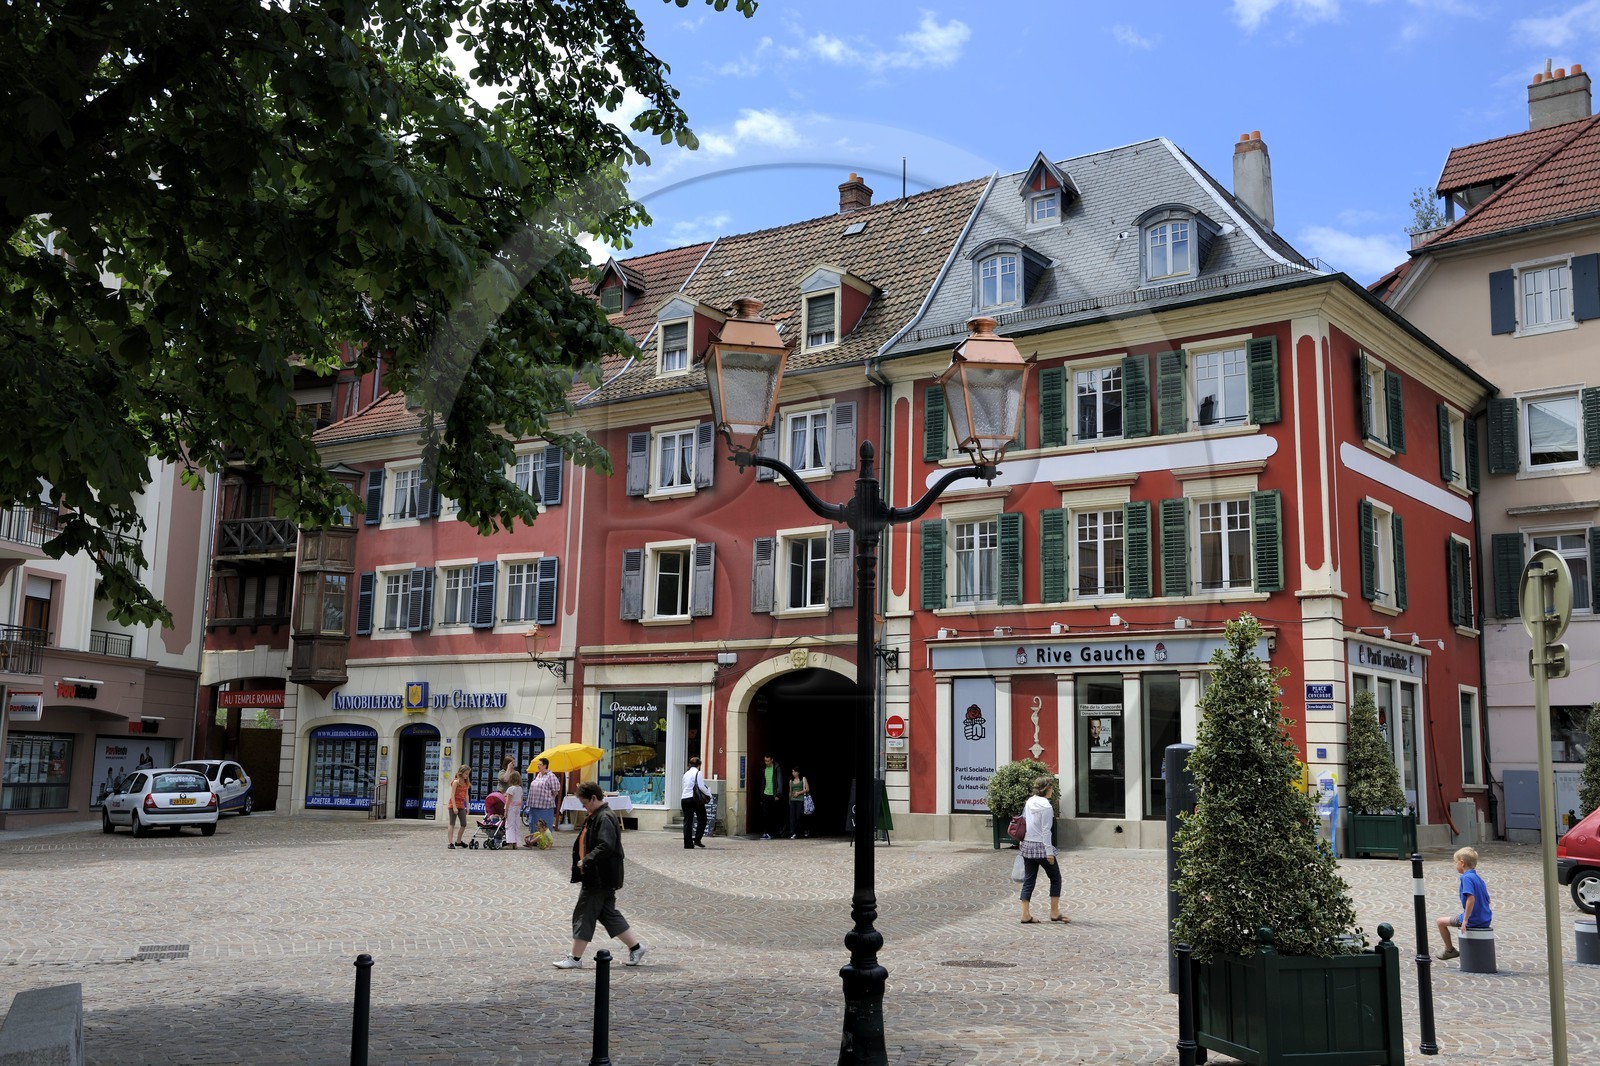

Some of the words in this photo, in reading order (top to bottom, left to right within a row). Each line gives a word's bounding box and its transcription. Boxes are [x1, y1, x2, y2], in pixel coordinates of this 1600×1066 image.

[1036, 646, 1072, 663] Rive
[1080, 644, 1145, 662] Gauche
[1367, 647, 1381, 665] Parti
[1383, 652, 1408, 671] socialiste
[225, 694, 234, 704] AU
[235, 694, 256, 704] TEMPLE
[256, 693, 282, 704] ROMAIN
[609, 701, 646, 712] Douceurs
[646, 702, 658, 712] des
[617, 711, 649, 725] Régions
[480, 726, 532, 737] 03.89.66.55.44
